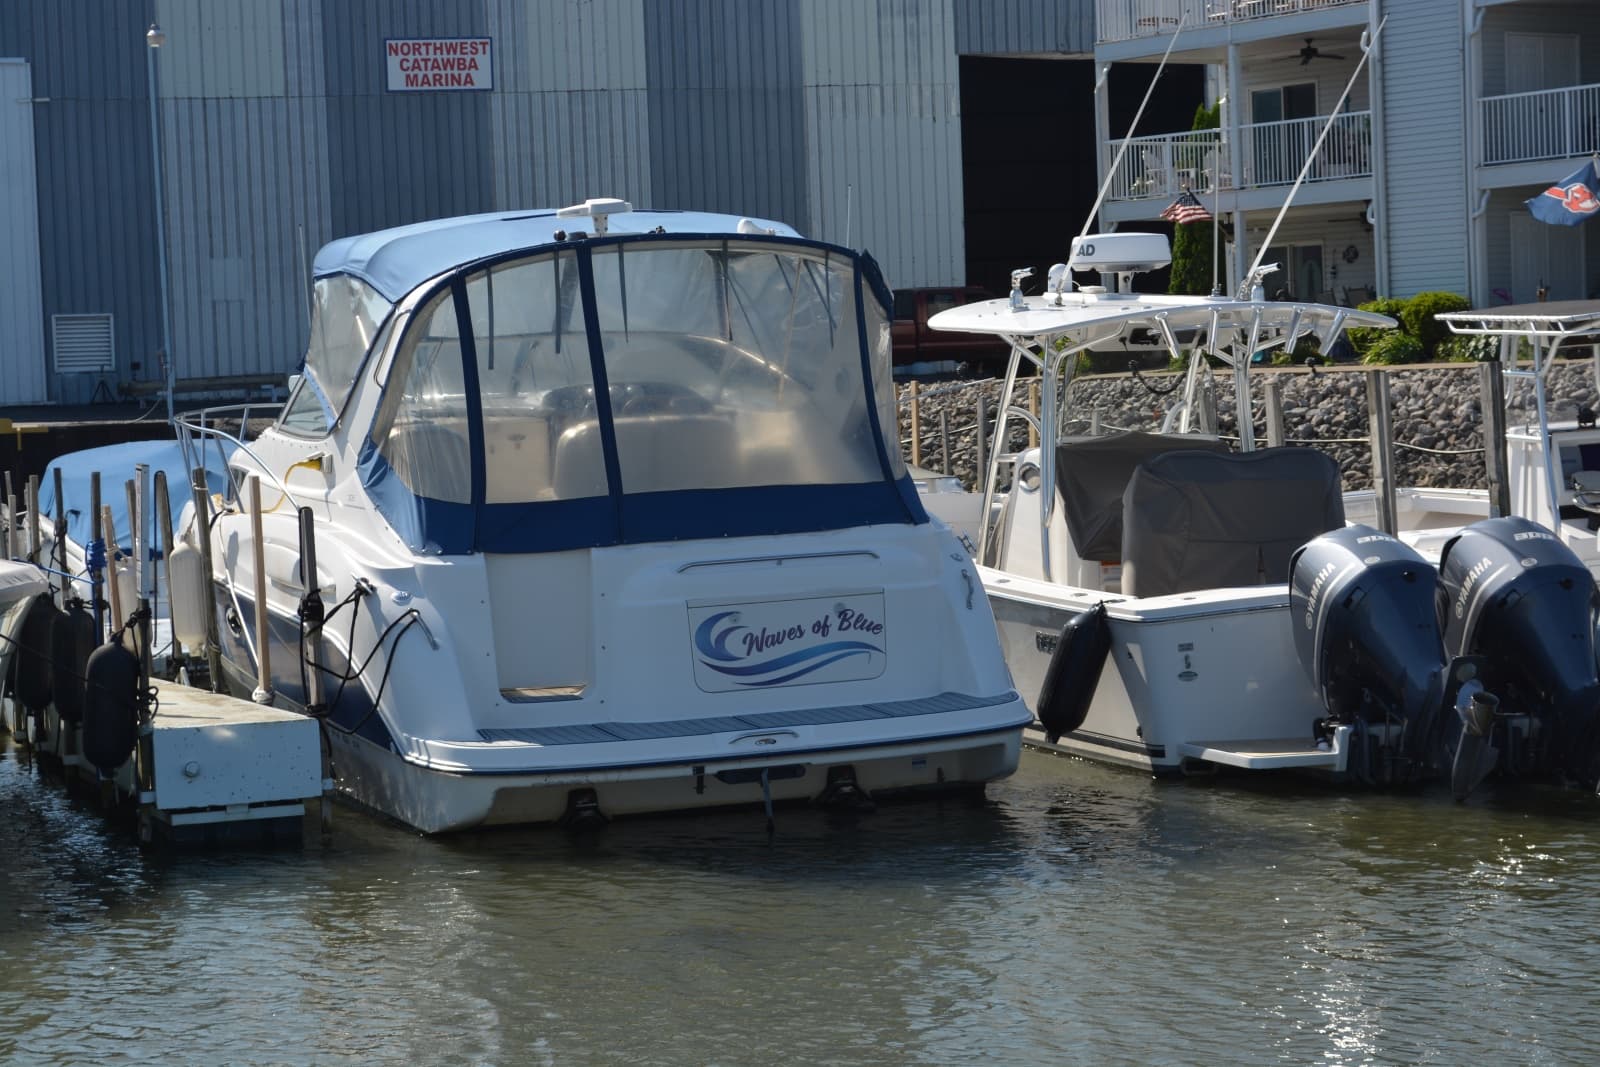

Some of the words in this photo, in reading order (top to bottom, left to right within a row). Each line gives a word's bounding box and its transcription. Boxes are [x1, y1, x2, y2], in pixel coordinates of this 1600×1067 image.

[388, 41, 489, 56] NORTHWEST
[399, 57, 479, 71] CATAWBA
[405, 73, 475, 87] MARINA
[1306, 562, 1336, 613] YAMAHA
[1458, 557, 1492, 605] YAMAHA
[742, 624, 805, 656] Waves
[812, 615, 832, 637] of
[837, 608, 883, 635] Blue
